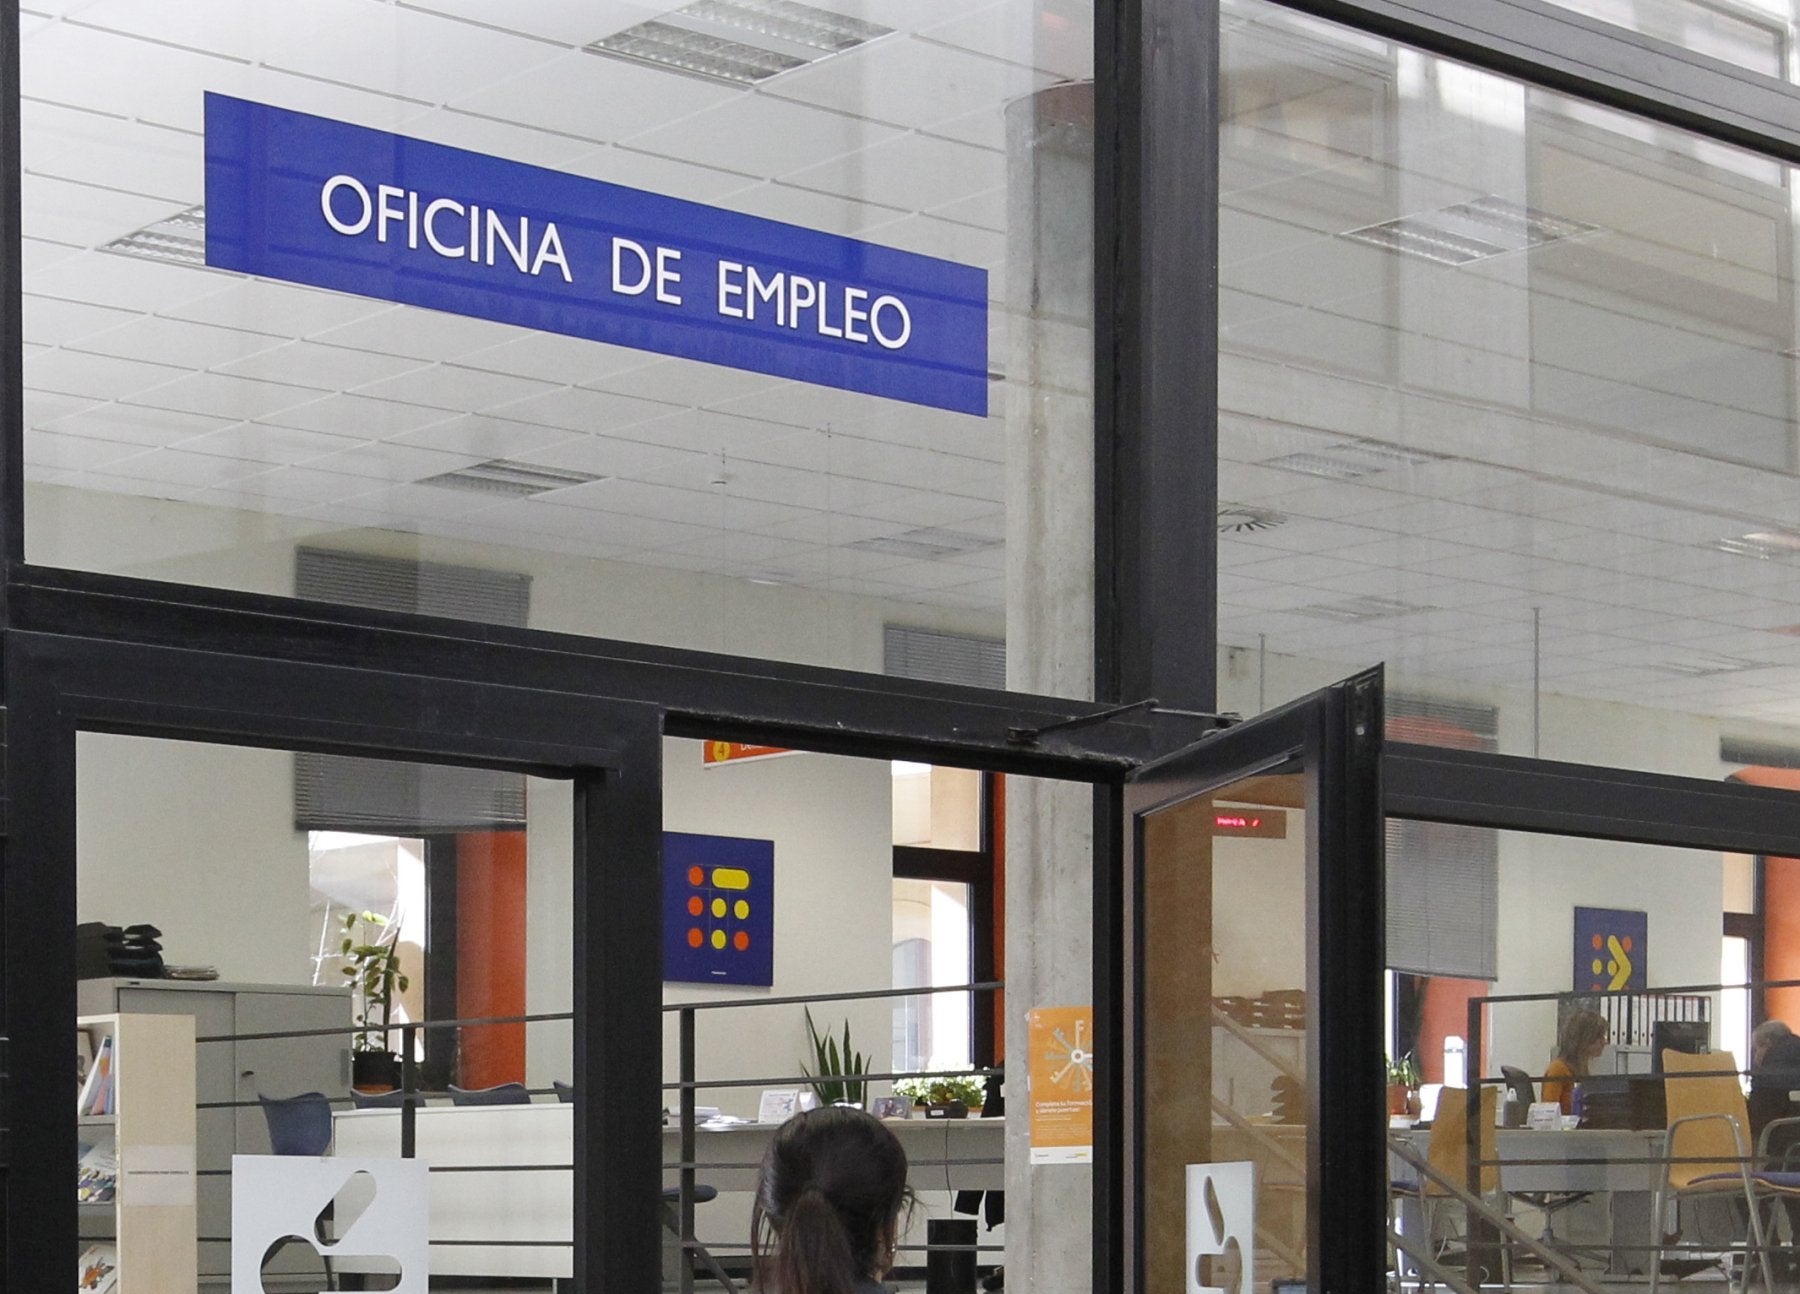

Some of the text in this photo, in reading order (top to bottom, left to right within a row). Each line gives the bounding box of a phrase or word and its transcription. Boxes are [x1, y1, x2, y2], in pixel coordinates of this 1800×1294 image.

[322, 174, 910, 348] OFICINA DE EMPLEO
